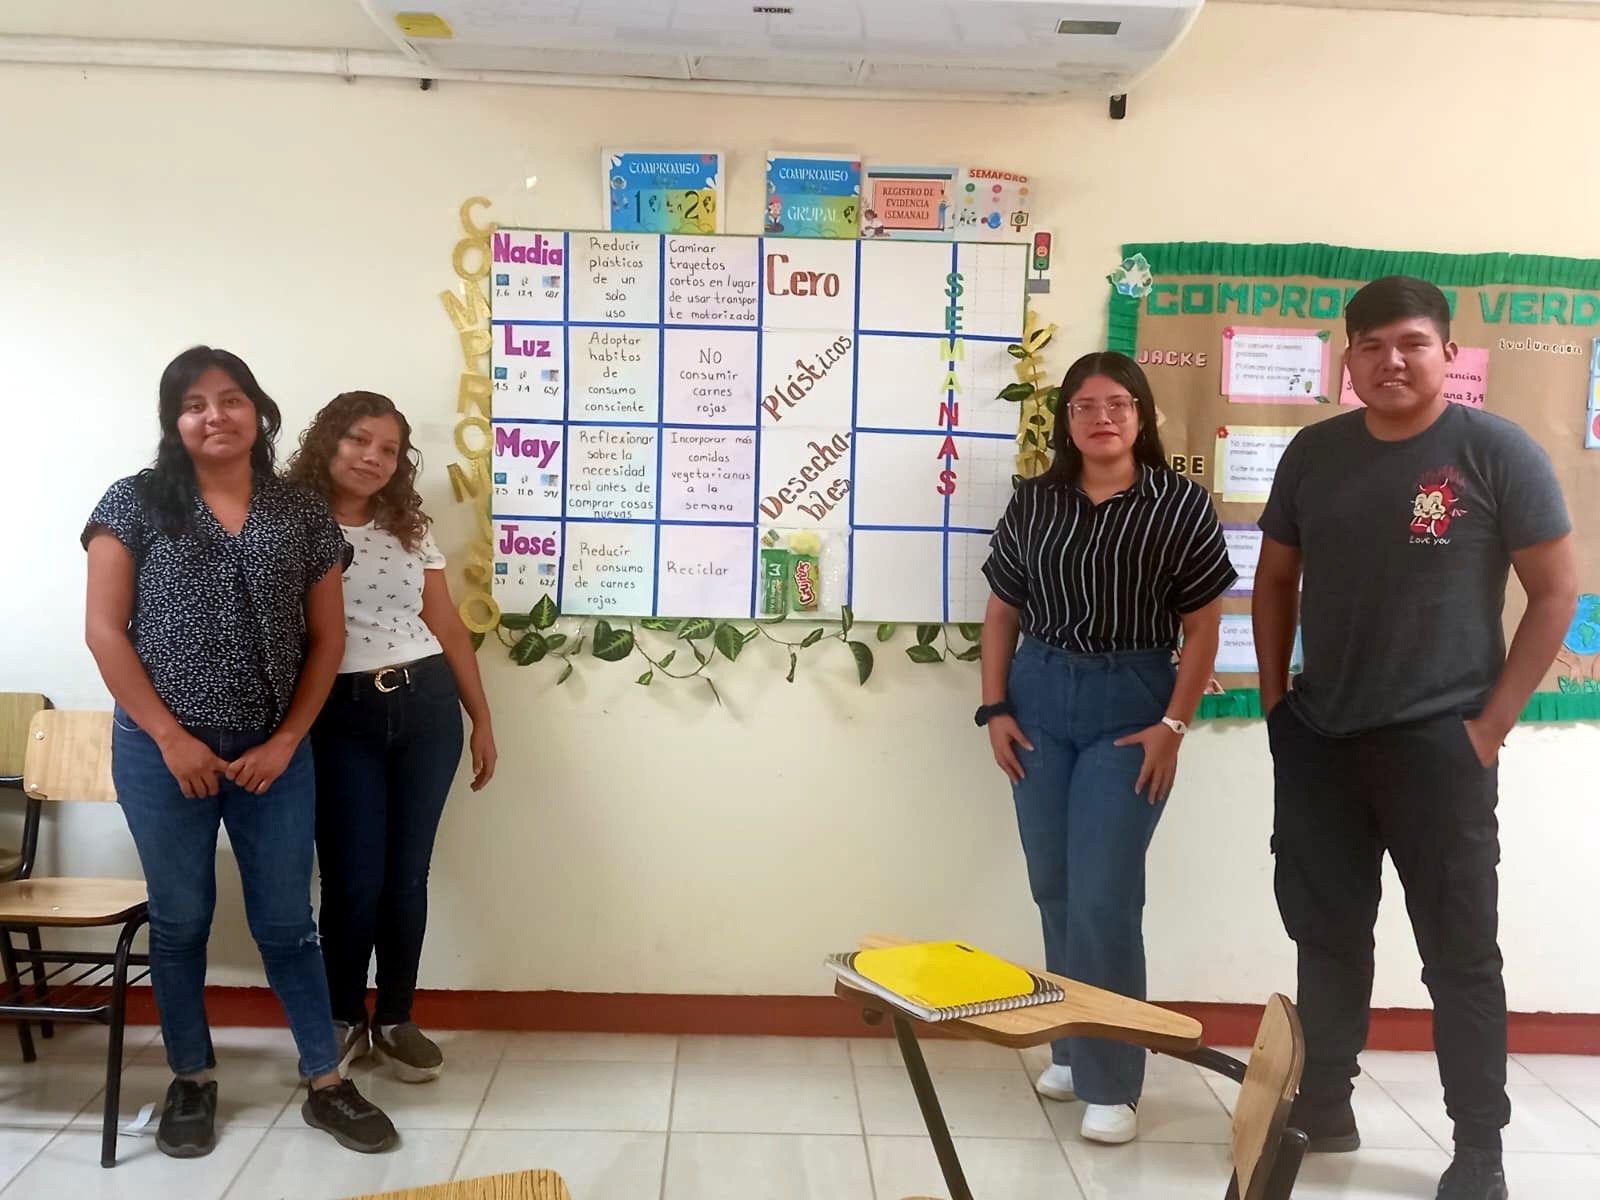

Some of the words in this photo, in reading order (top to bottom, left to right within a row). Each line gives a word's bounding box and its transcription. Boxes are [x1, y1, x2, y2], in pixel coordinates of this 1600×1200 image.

[882, 188, 921, 196] REGISTRO
[924, 188, 934, 196] DE
[886, 199, 929, 207] EVIDENCIA
[884, 210, 929, 219] (SEMANAL)
[493, 233, 562, 265] Nadia
[590, 237, 640, 252] Reducir
[669, 240, 716, 254] Caminar
[669, 259, 726, 277] trayectos
[593, 275, 607, 285] de
[621, 276, 635, 285] un
[766, 253, 840, 297] Cero
[669, 277, 705, 287] cortos
[709, 278, 724, 287] en
[727, 274, 756, 293] lugar
[669, 292, 682, 303] de
[687, 294, 711, 303] usar
[1148, 282, 1457, 320] COMPRO
[1479, 291, 1600, 326] VERD
[605, 309, 625, 318] uso
[669, 309, 681, 319] te
[691, 311, 755, 321] motorizado
[504, 323, 551, 358] Luz
[589, 332, 640, 348] Adoptar
[699, 349, 722, 364] NO
[1138, 351, 1208, 368] JACKE
[603, 367, 618, 378] de
[679, 367, 738, 381] consumir
[761, 335, 851, 422] Plásticos
[588, 386, 636, 395] consumo
[936, 272, 965, 496] SEMANAS
[693, 387, 732, 397] carnes
[585, 402, 645, 412] consciente
[697, 404, 727, 417] rojas
[580, 431, 654, 445] Reflexionar
[672, 432, 726, 446] Incorporar
[495, 427, 560, 468] May
[587, 450, 617, 460] sobre
[622, 450, 632, 460] la
[688, 452, 730, 462] comidas
[583, 465, 645, 477] necesidad
[672, 468, 750, 483] vegetarianas
[570, 481, 591, 492] real
[596, 482, 626, 492] antes
[635, 482, 650, 493] de
[708, 482, 718, 493] la
[569, 498, 614, 510] comprar
[621, 500, 653, 509] cosas
[797, 477, 852, 522] bles
[685, 502, 733, 512] semana
[594, 510, 632, 519] nuevas
[500, 524, 556, 556] José
[1433, 537, 1451, 546] you
[580, 543, 630, 558] Reducir
[572, 560, 583, 572] el
[596, 564, 643, 573] consumo
[667, 561, 728, 576] Reciclar
[575, 576, 588, 588] de
[600, 579, 635, 589] carnes
[587, 594, 616, 609] rojas
